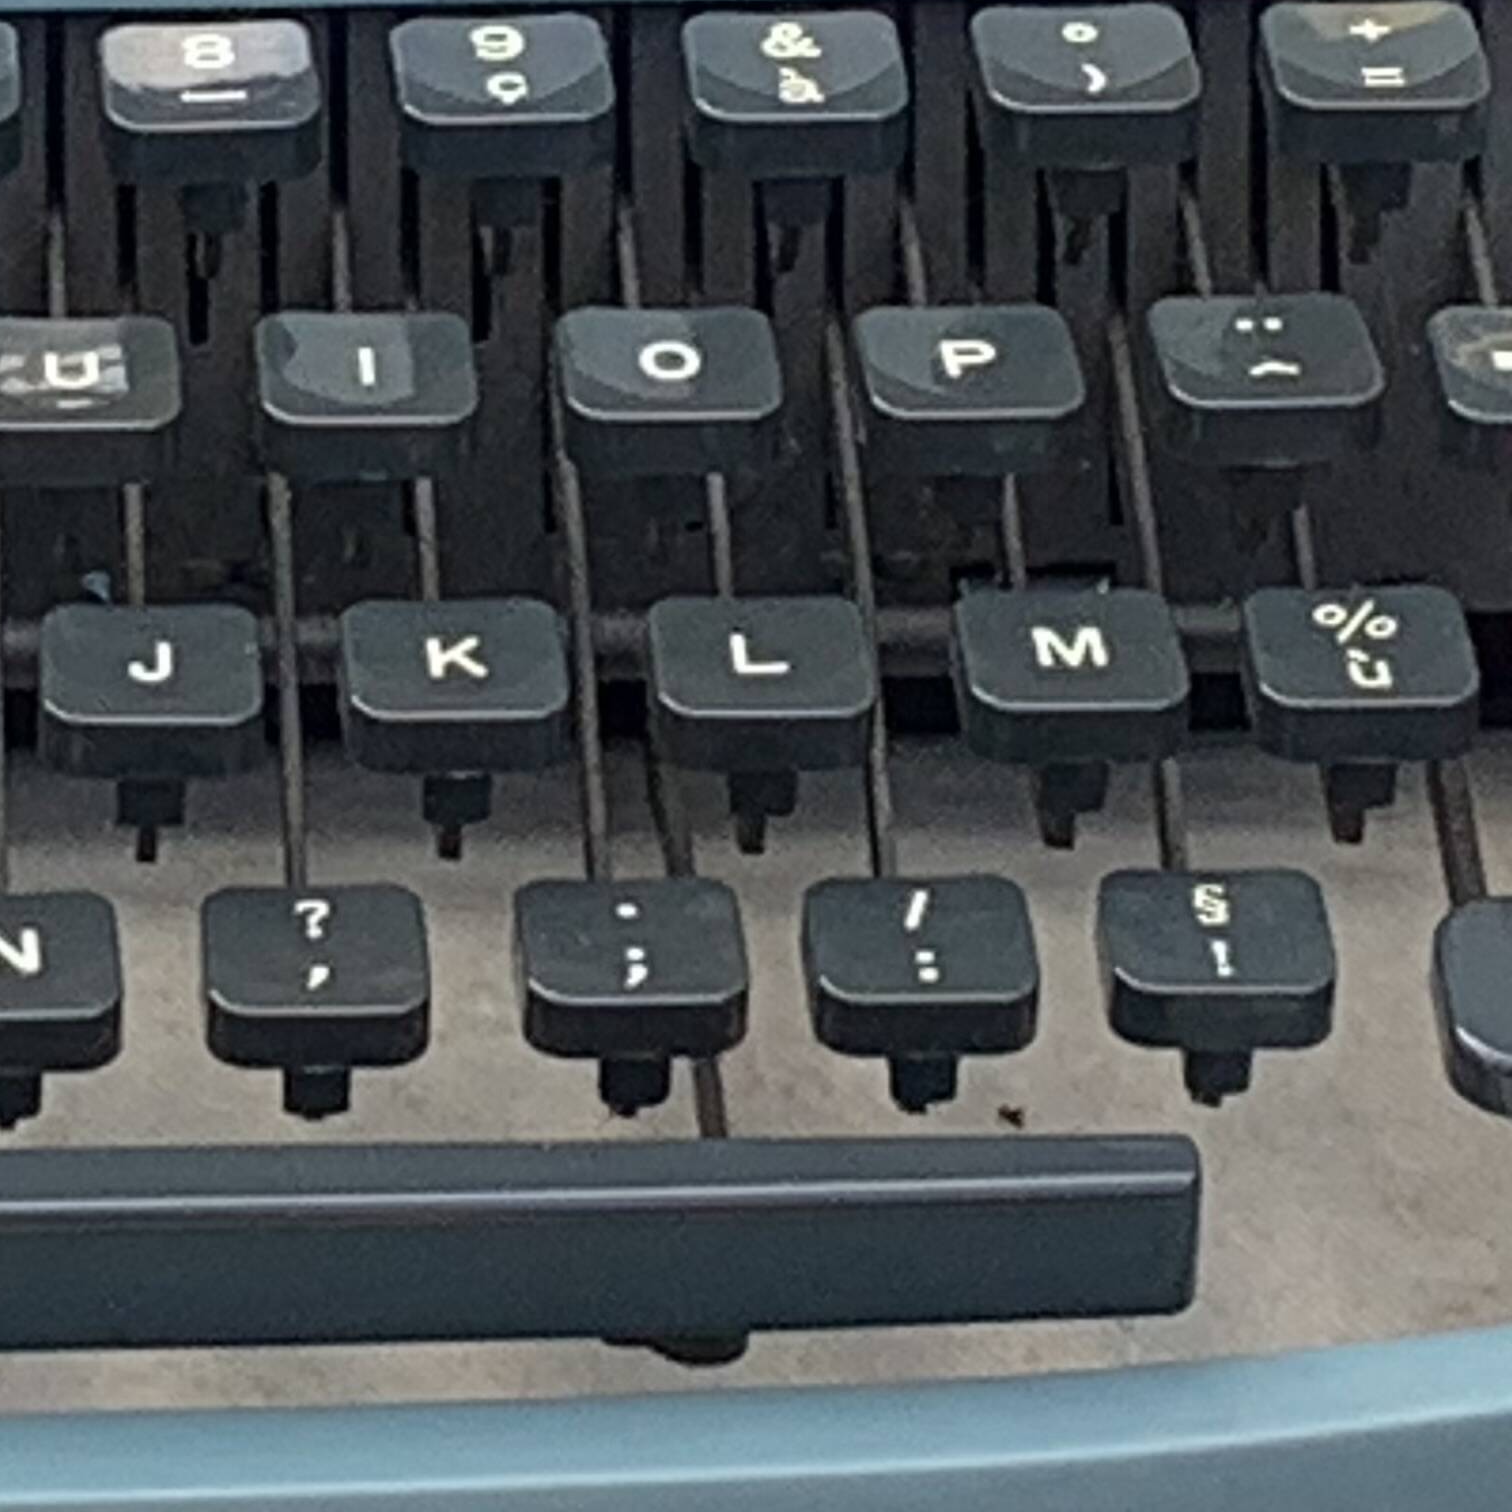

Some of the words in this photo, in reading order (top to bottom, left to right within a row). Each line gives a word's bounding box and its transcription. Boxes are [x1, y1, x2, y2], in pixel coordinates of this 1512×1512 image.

[180, 33, 236, 70] 8
[469, 24, 525, 61] 9
[761, 21, 822, 59] &
[44, 351, 100, 389] U
[357, 347, 376, 386] I
[638, 340, 701, 381] O
[939, 339, 996, 378] P
[1313, 601, 1397, 643] %
[128, 641, 172, 682] J
[426, 637, 487, 678] K
[730, 633, 789, 674] L
[1031, 627, 1108, 667] M
[295, 900, 329, 938] ?
[1211, 940, 1233, 977] !
